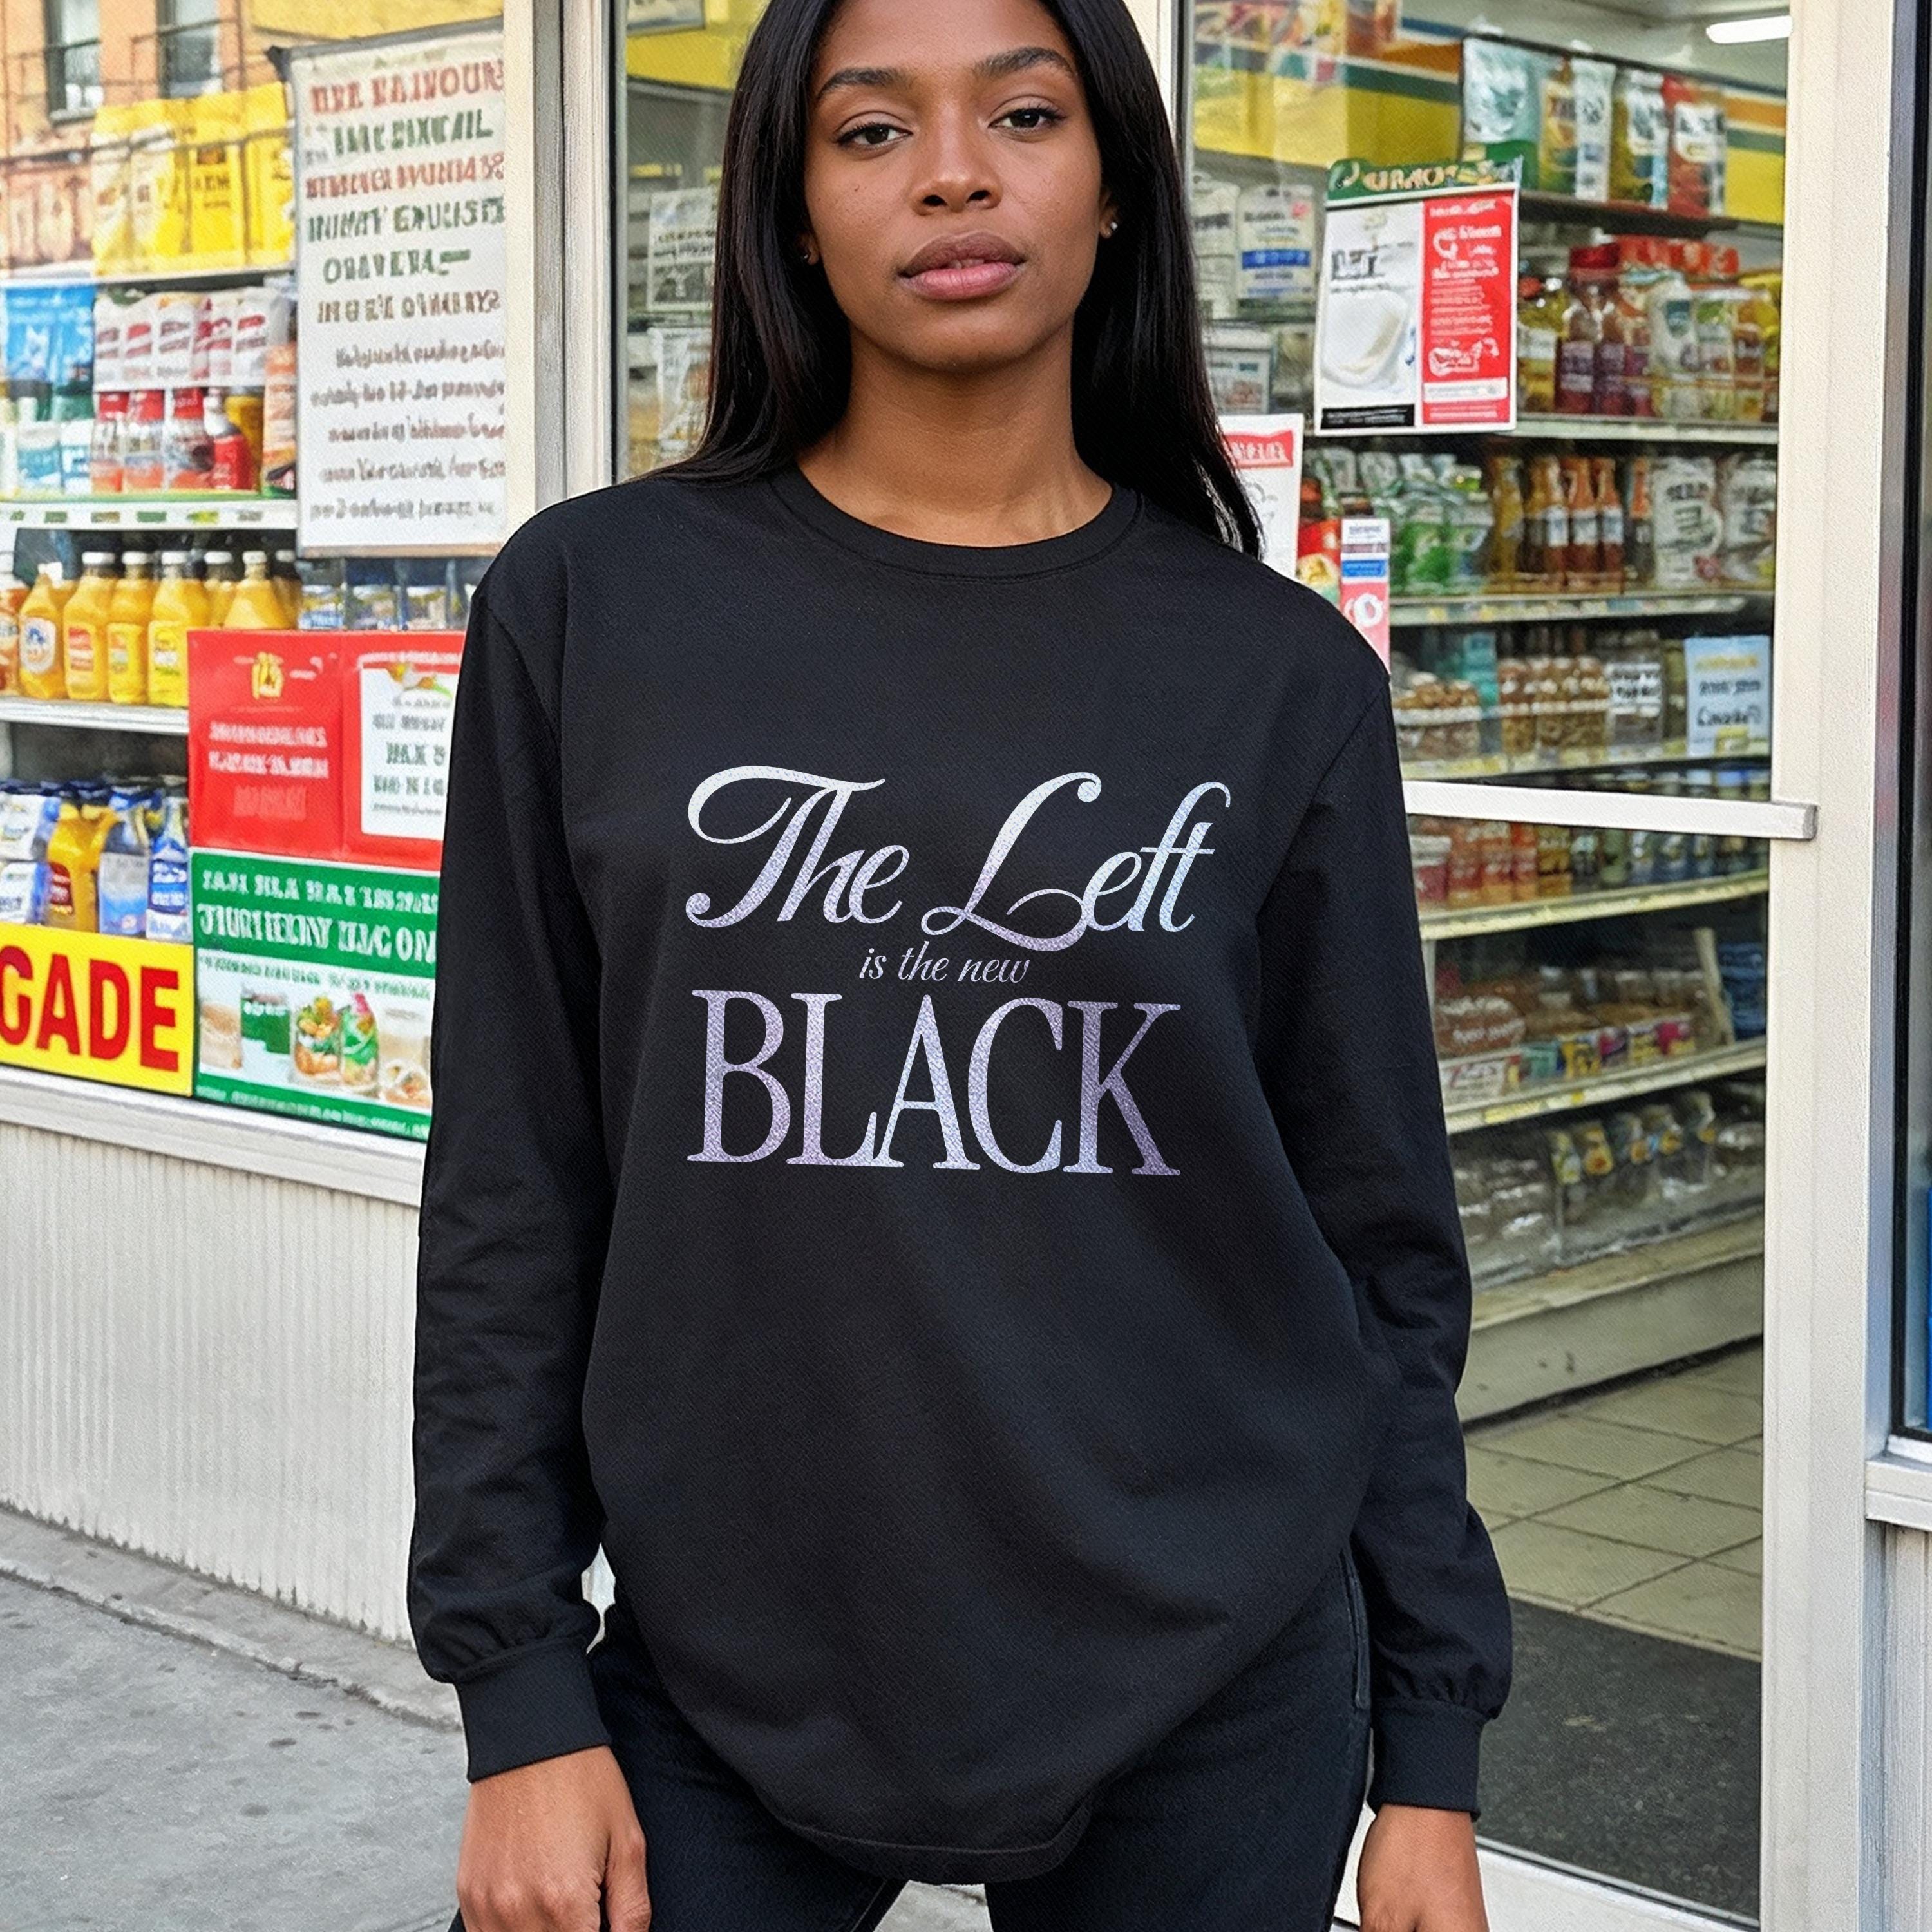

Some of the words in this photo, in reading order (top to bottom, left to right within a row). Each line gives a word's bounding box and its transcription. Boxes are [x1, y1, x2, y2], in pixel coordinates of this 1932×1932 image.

[685, 765, 909, 928] The
[921, 772, 1231, 951] Left
[0, 945, 180, 1073] GADE
[859, 948, 887, 980] is
[898, 941, 947, 981] the
[958, 959, 1030, 983] new
[687, 990, 1182, 1176] BLACK
